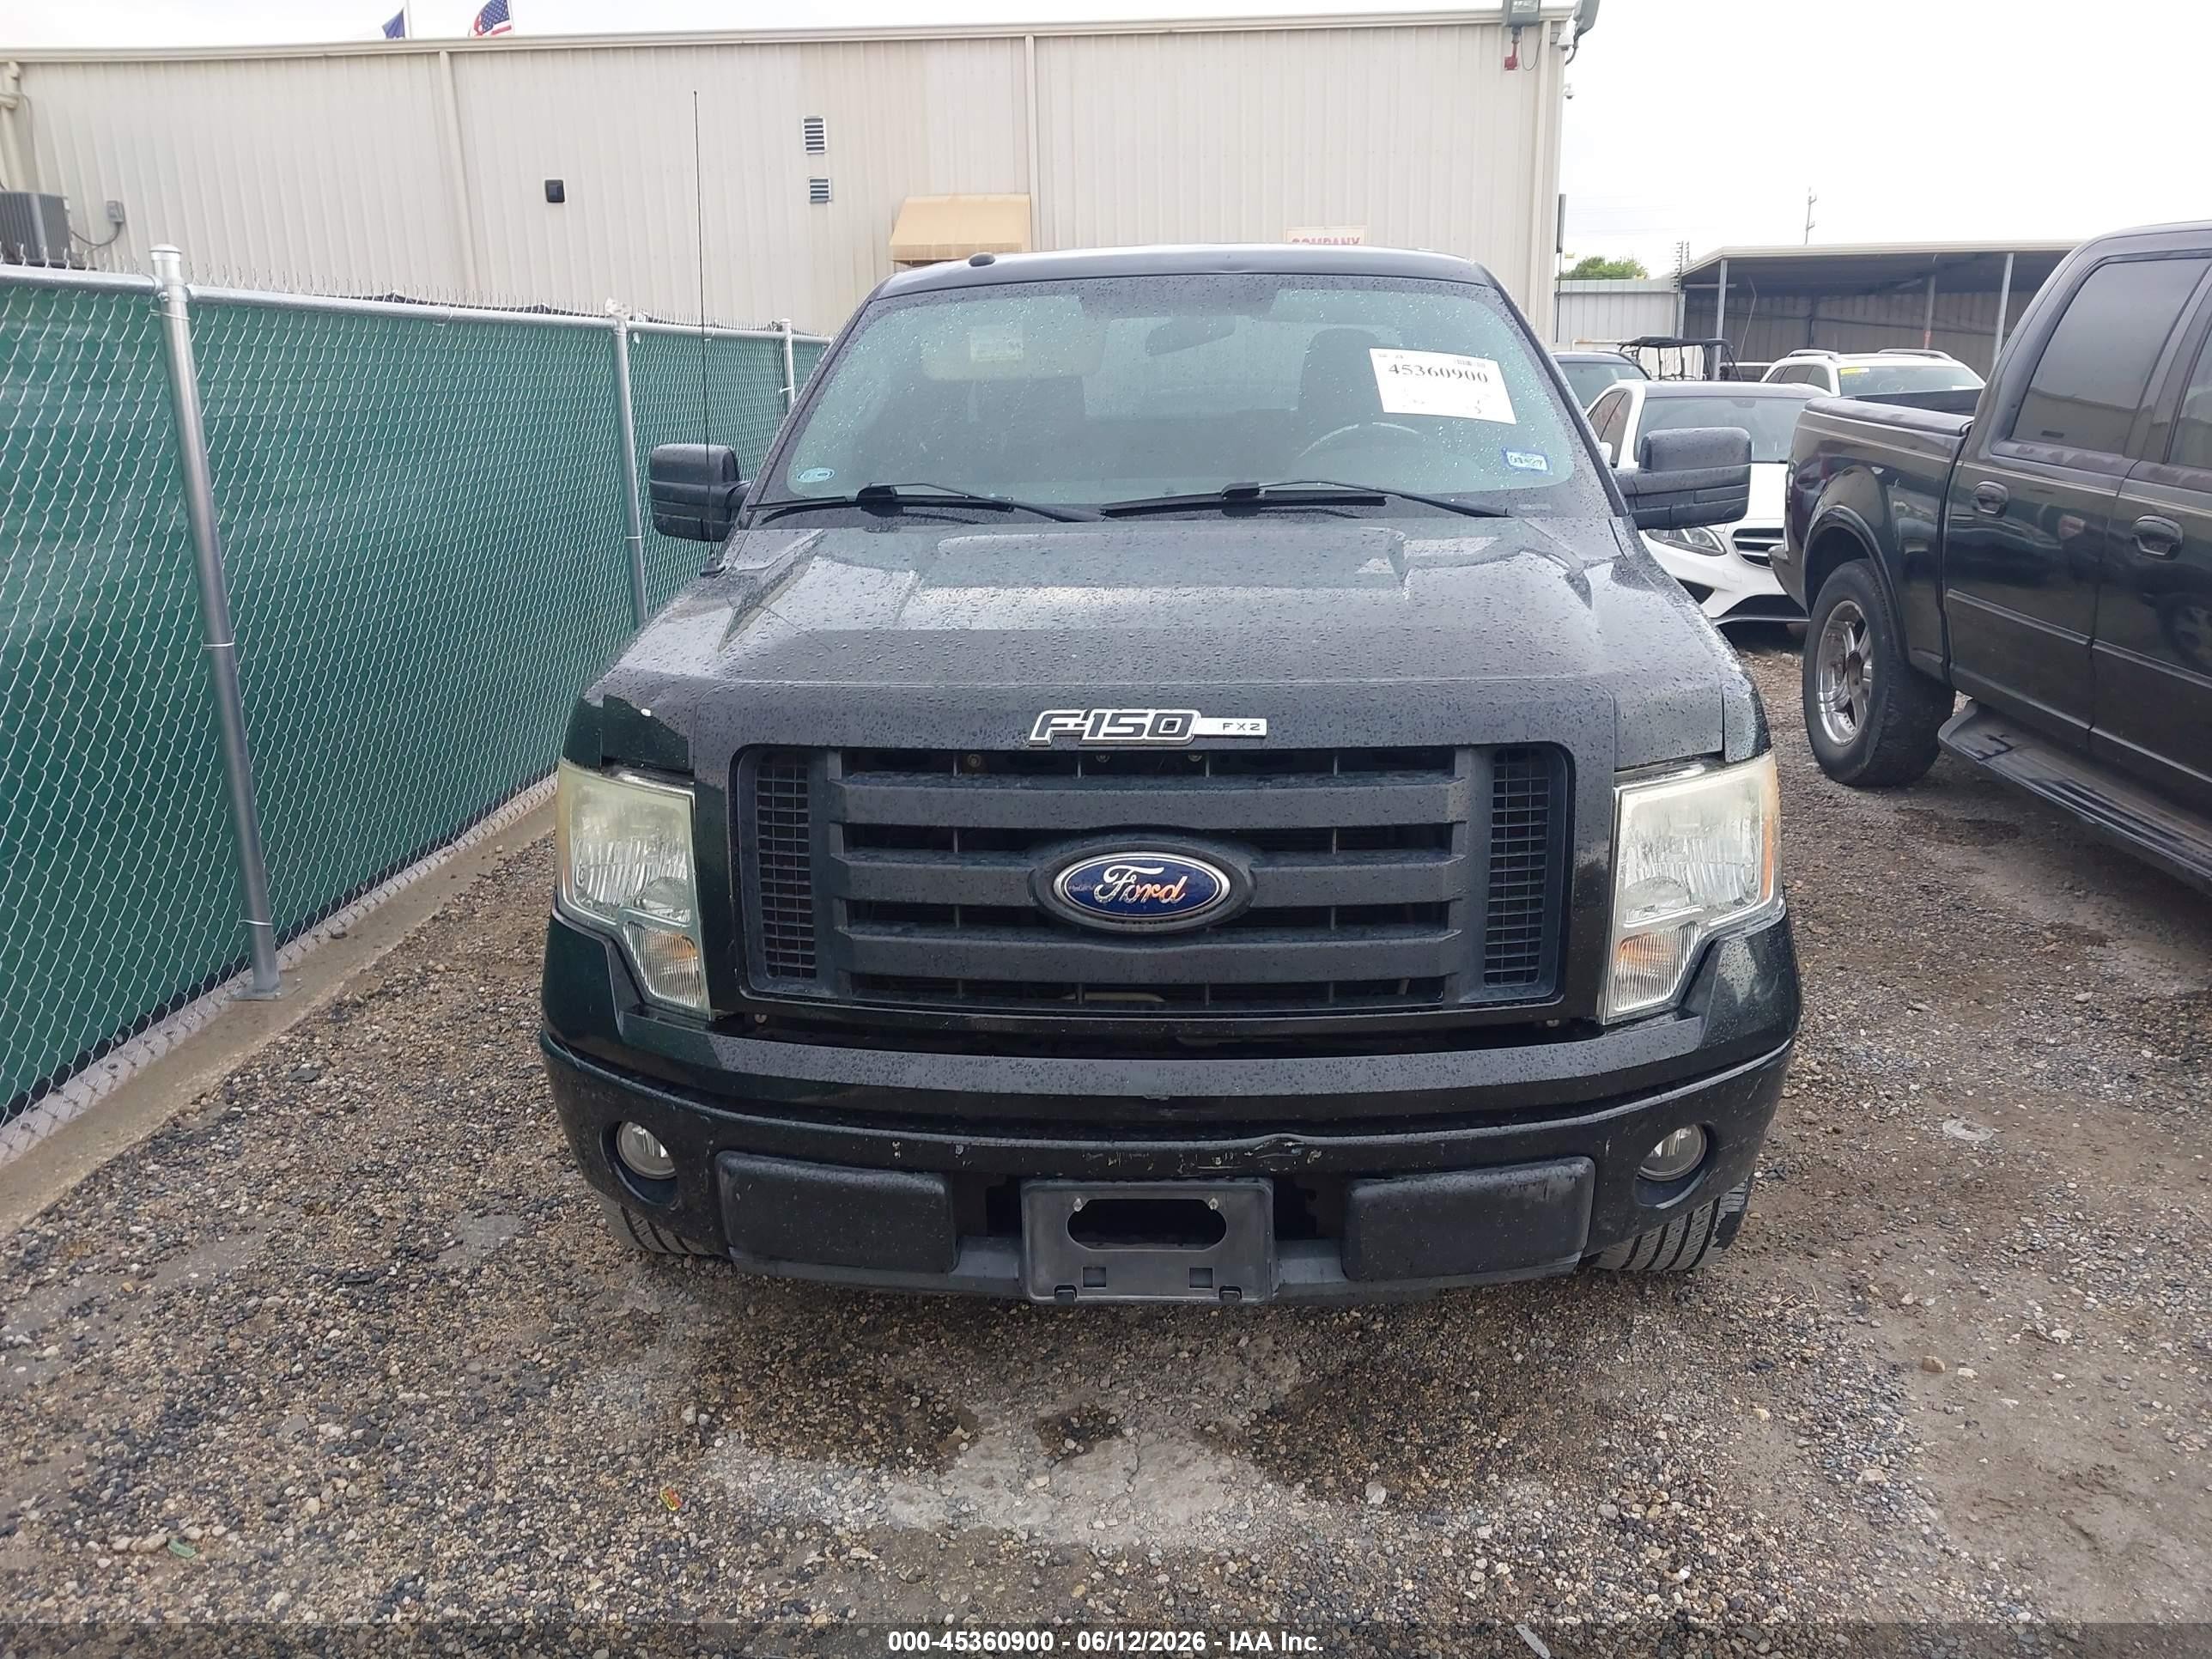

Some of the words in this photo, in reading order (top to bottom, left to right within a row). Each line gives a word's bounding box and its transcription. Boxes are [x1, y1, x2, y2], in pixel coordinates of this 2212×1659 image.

[1388, 363, 1489, 384] 45360900
[1030, 709, 1201, 745] F-150
[1222, 722, 1261, 731] FX2
[1093, 865, 1188, 904] Ford
